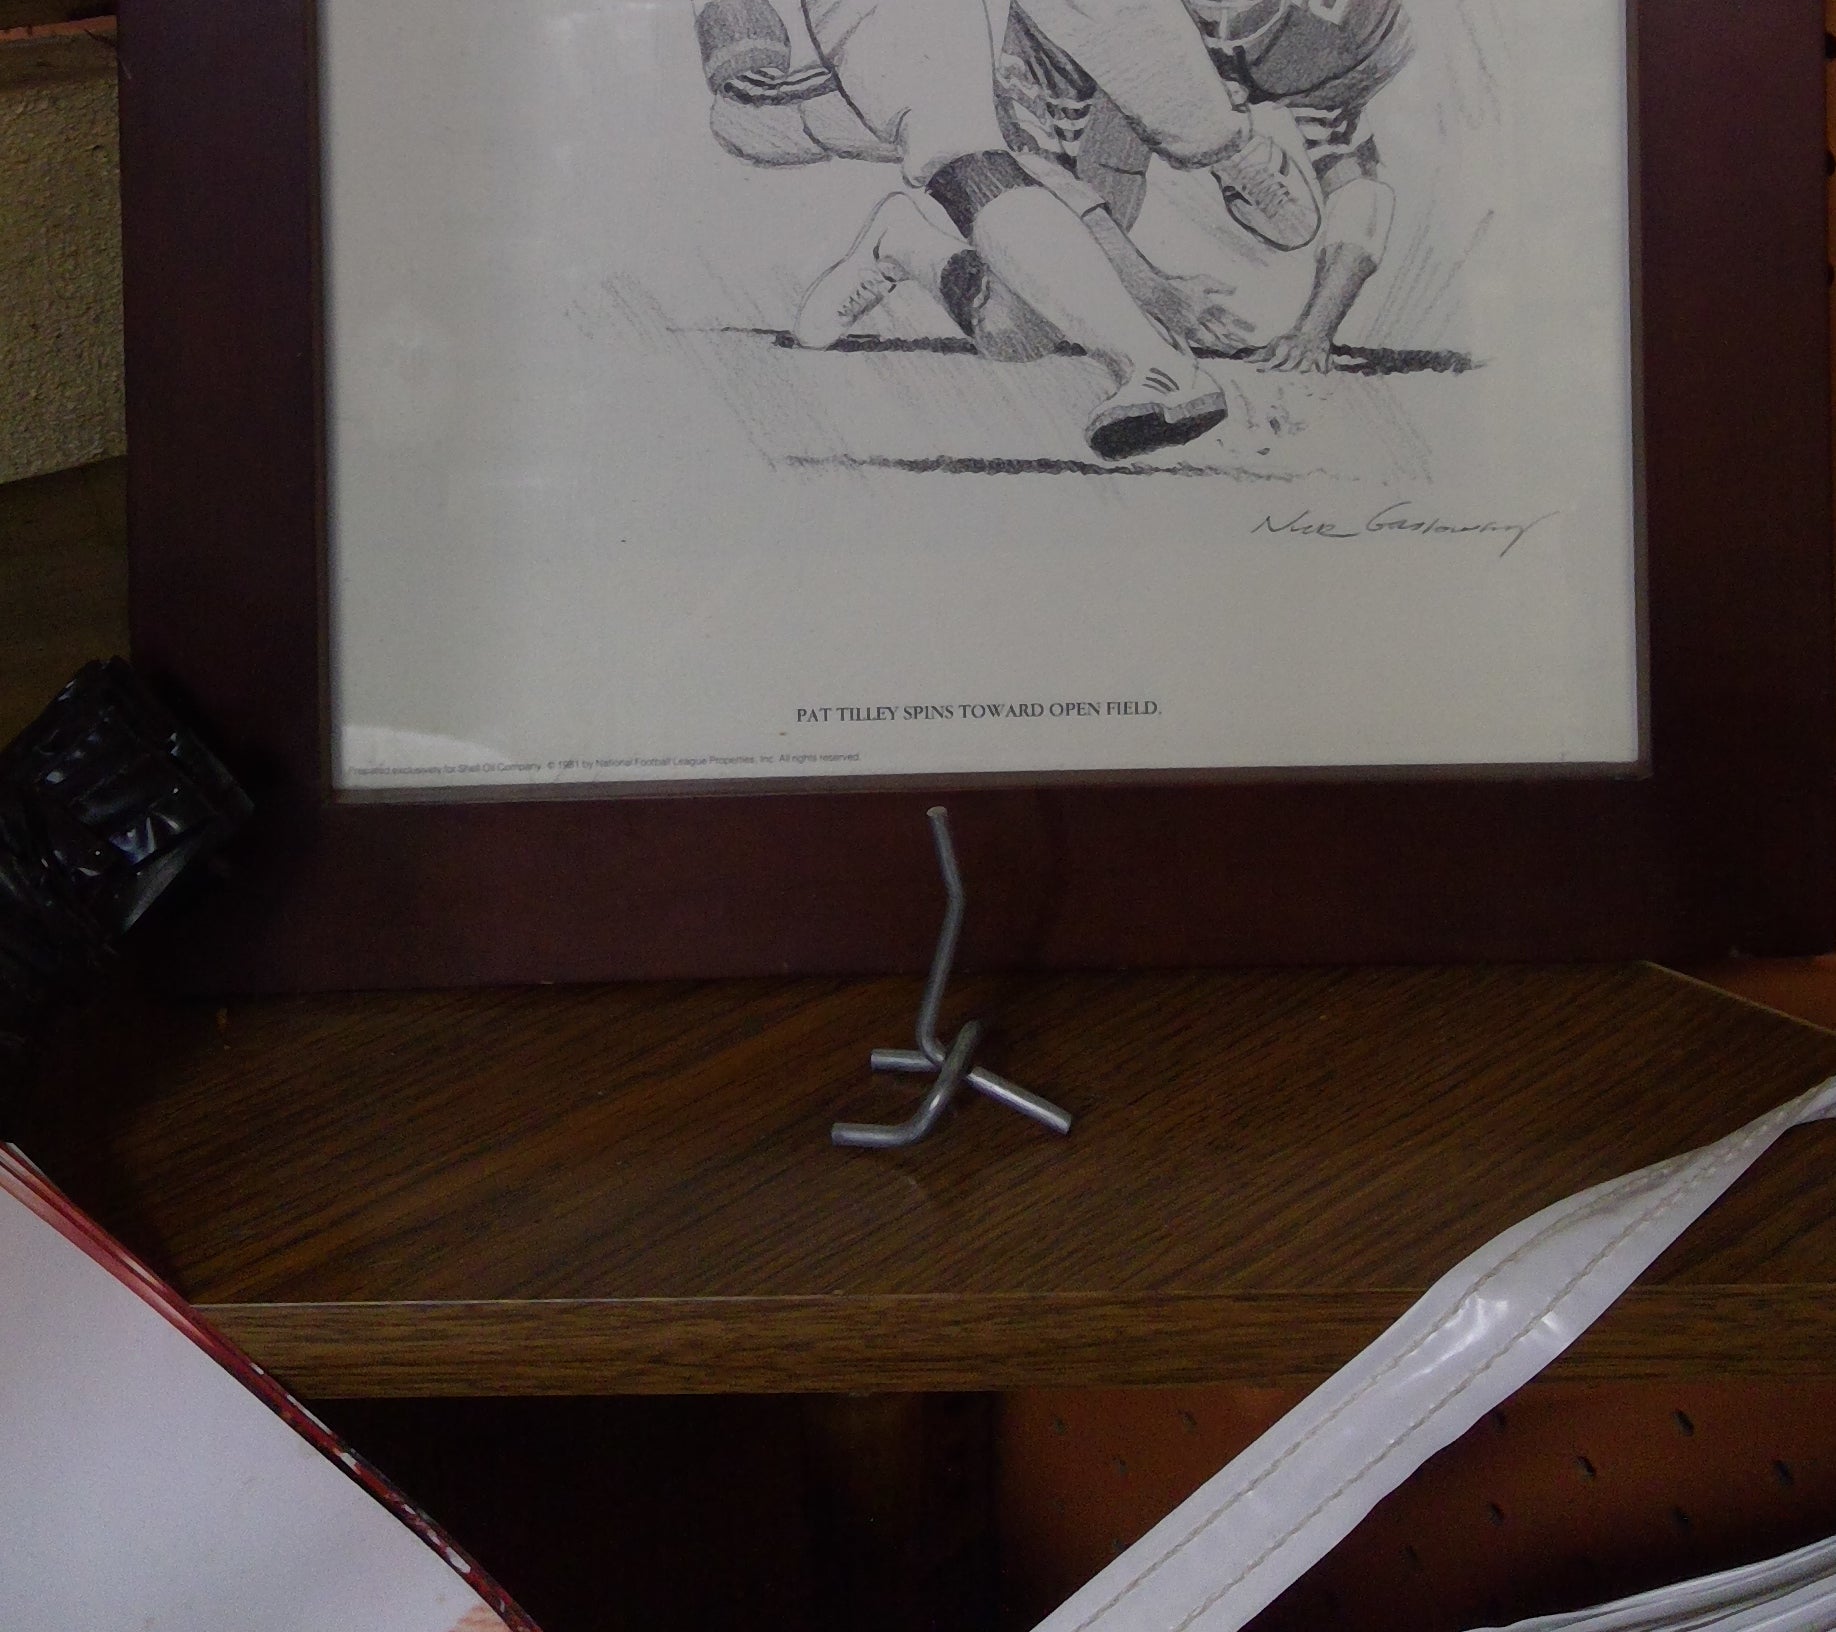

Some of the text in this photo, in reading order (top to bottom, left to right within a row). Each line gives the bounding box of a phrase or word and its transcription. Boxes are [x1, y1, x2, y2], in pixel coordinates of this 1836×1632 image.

[796, 700, 1163, 723] PAT TILLEY SPINS TOWARD OPEN FIELD.
[595, 758, 634, 767] National
[634, 756, 672, 767] Football
[672, 755, 707, 767] League
[792, 753, 818, 764] rights
